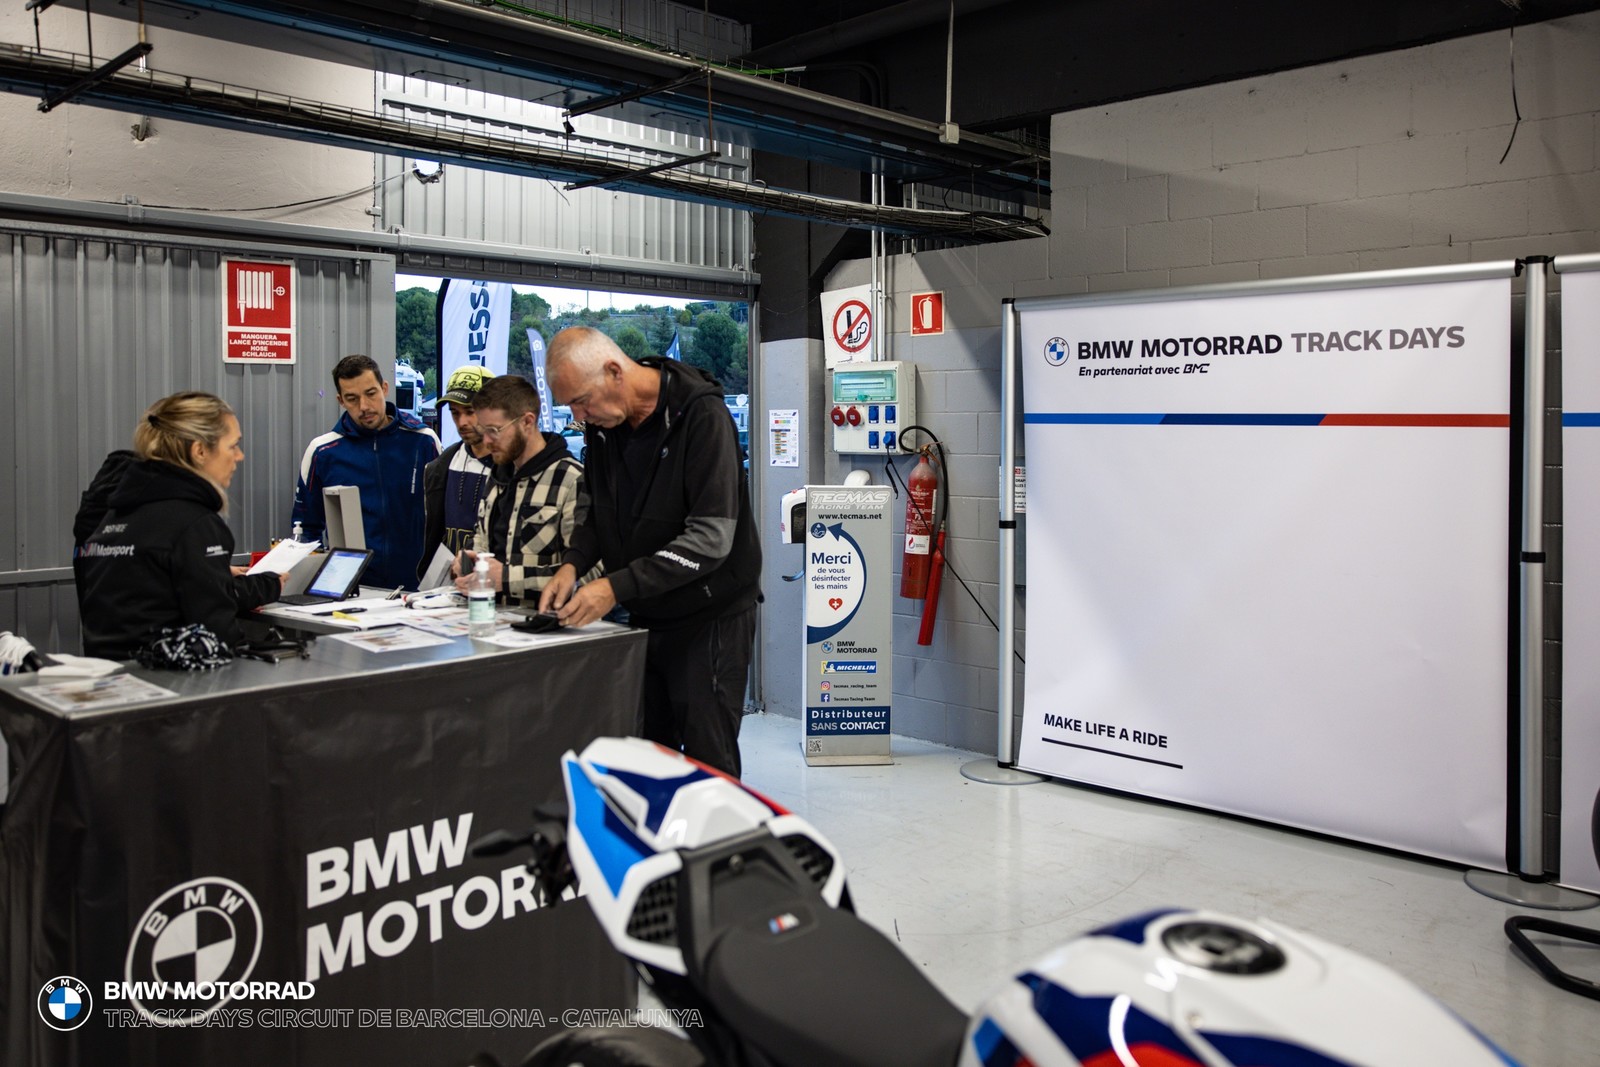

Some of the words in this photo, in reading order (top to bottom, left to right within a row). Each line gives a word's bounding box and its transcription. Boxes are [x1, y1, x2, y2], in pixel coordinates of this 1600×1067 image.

[1077, 340, 1134, 360] BMW
[1140, 334, 1283, 358] MOTORRAD
[1290, 329, 1383, 353] TRACK
[1389, 325, 1466, 350] DAYS
[1078, 366, 1092, 377] En
[1093, 364, 1153, 378] partenariat
[1154, 366, 1180, 375] avec
[1182, 363, 1211, 374] BMC
[810, 490, 891, 505] TECMAS
[811, 552, 851, 565] Merci
[811, 574, 851, 582] désinfecter
[811, 710, 887, 719] Distributeur
[811, 722, 838, 731] SANS
[839, 721, 887, 730] CONTACT
[1043, 713, 1082, 732] MAKE
[1085, 722, 1116, 738] LIFE
[1119, 728, 1130, 741] A
[1132, 730, 1168, 748] RIDE
[306, 812, 474, 909] BMW
